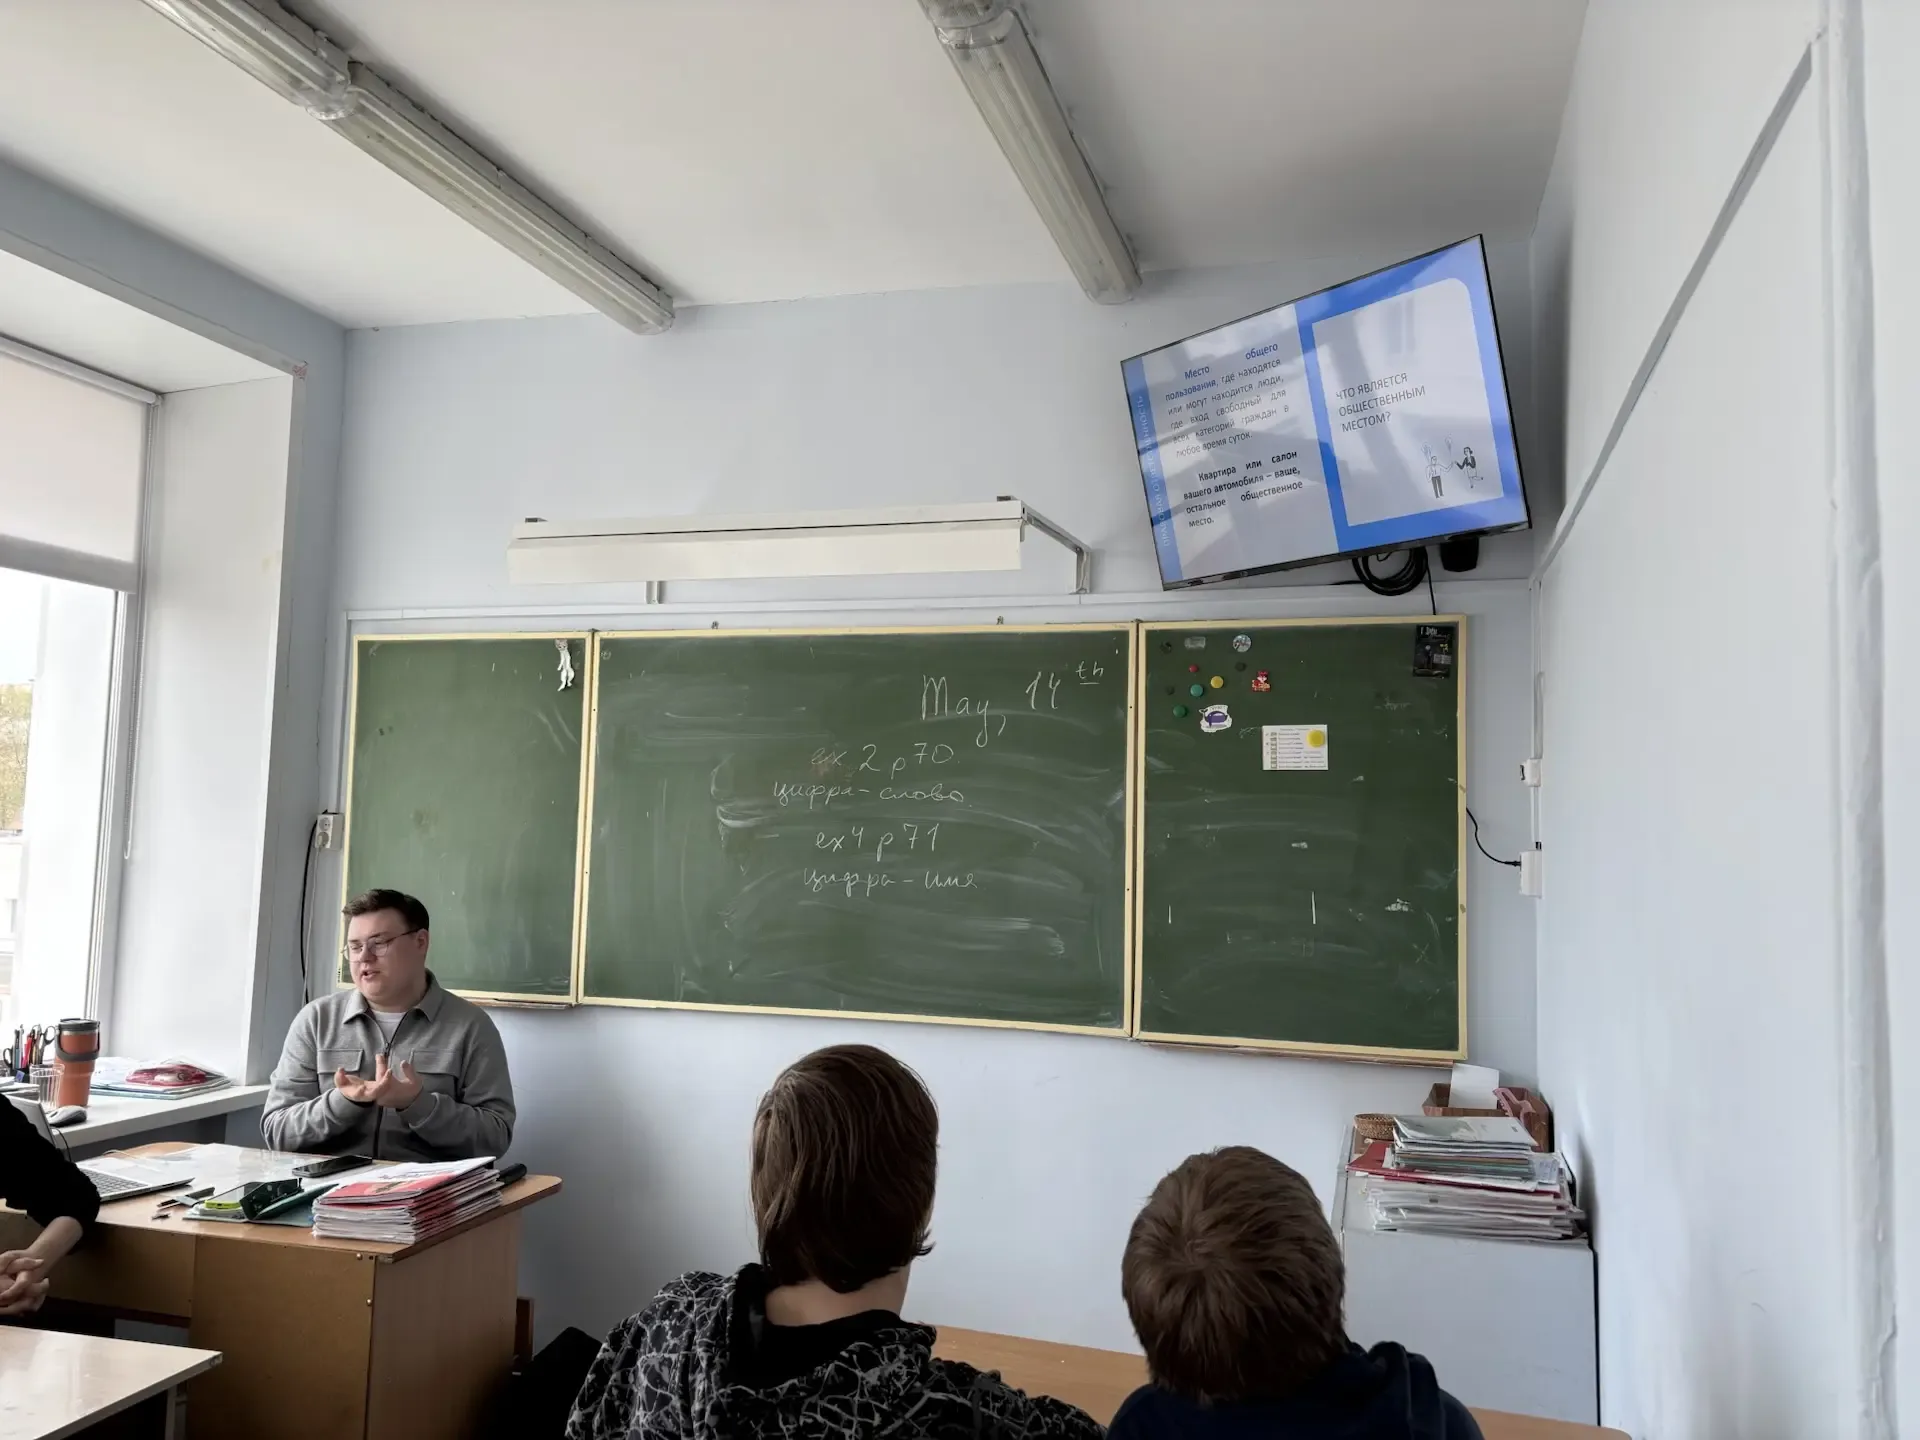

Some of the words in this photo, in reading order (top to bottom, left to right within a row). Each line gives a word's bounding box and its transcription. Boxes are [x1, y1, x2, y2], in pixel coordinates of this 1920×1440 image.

[1184, 366, 1210, 380] Место
[1245, 343, 1278, 360] общего
[1165, 380, 1219, 401] пользования,
[1221, 373, 1236, 385] где
[1238, 358, 1281, 378] находятся
[1167, 404, 1183, 416] или
[1185, 397, 1208, 412] могут
[1211, 383, 1254, 403] находится
[1257, 376, 1284, 389] люди,
[1336, 387, 1355, 400] ЧТО
[1357, 372, 1408, 395] ЯВЛЯЕТСЯ
[1170, 420, 1184, 431] где
[1190, 412, 1209, 424] вход
[1215, 395, 1262, 417] свободный
[1270, 389, 1287, 401] для
[1339, 384, 1426, 417] ОБЩЕСТВЕННЫМ
[1195, 420, 1236, 437] категорий
[1241, 408, 1277, 426] граждан
[1341, 411, 1391, 433] МЕСТОМ?
[1202, 438, 1227, 453] время
[1228, 431, 1253, 445] суток.
[1198, 466, 1237, 481] Квартира
[1245, 459, 1262, 470] или
[1271, 451, 1298, 464] салон
[1183, 487, 1212, 500] вашего
[1214, 474, 1264, 493] автомобиля
[1274, 466, 1301, 479] ваше,
[1186, 499, 1227, 514] остальное
[1240, 481, 1303, 502] общественное
[1188, 516, 1215, 527] место.
[921, 674, 1007, 748] May,
[858, 744, 880, 772] 2
